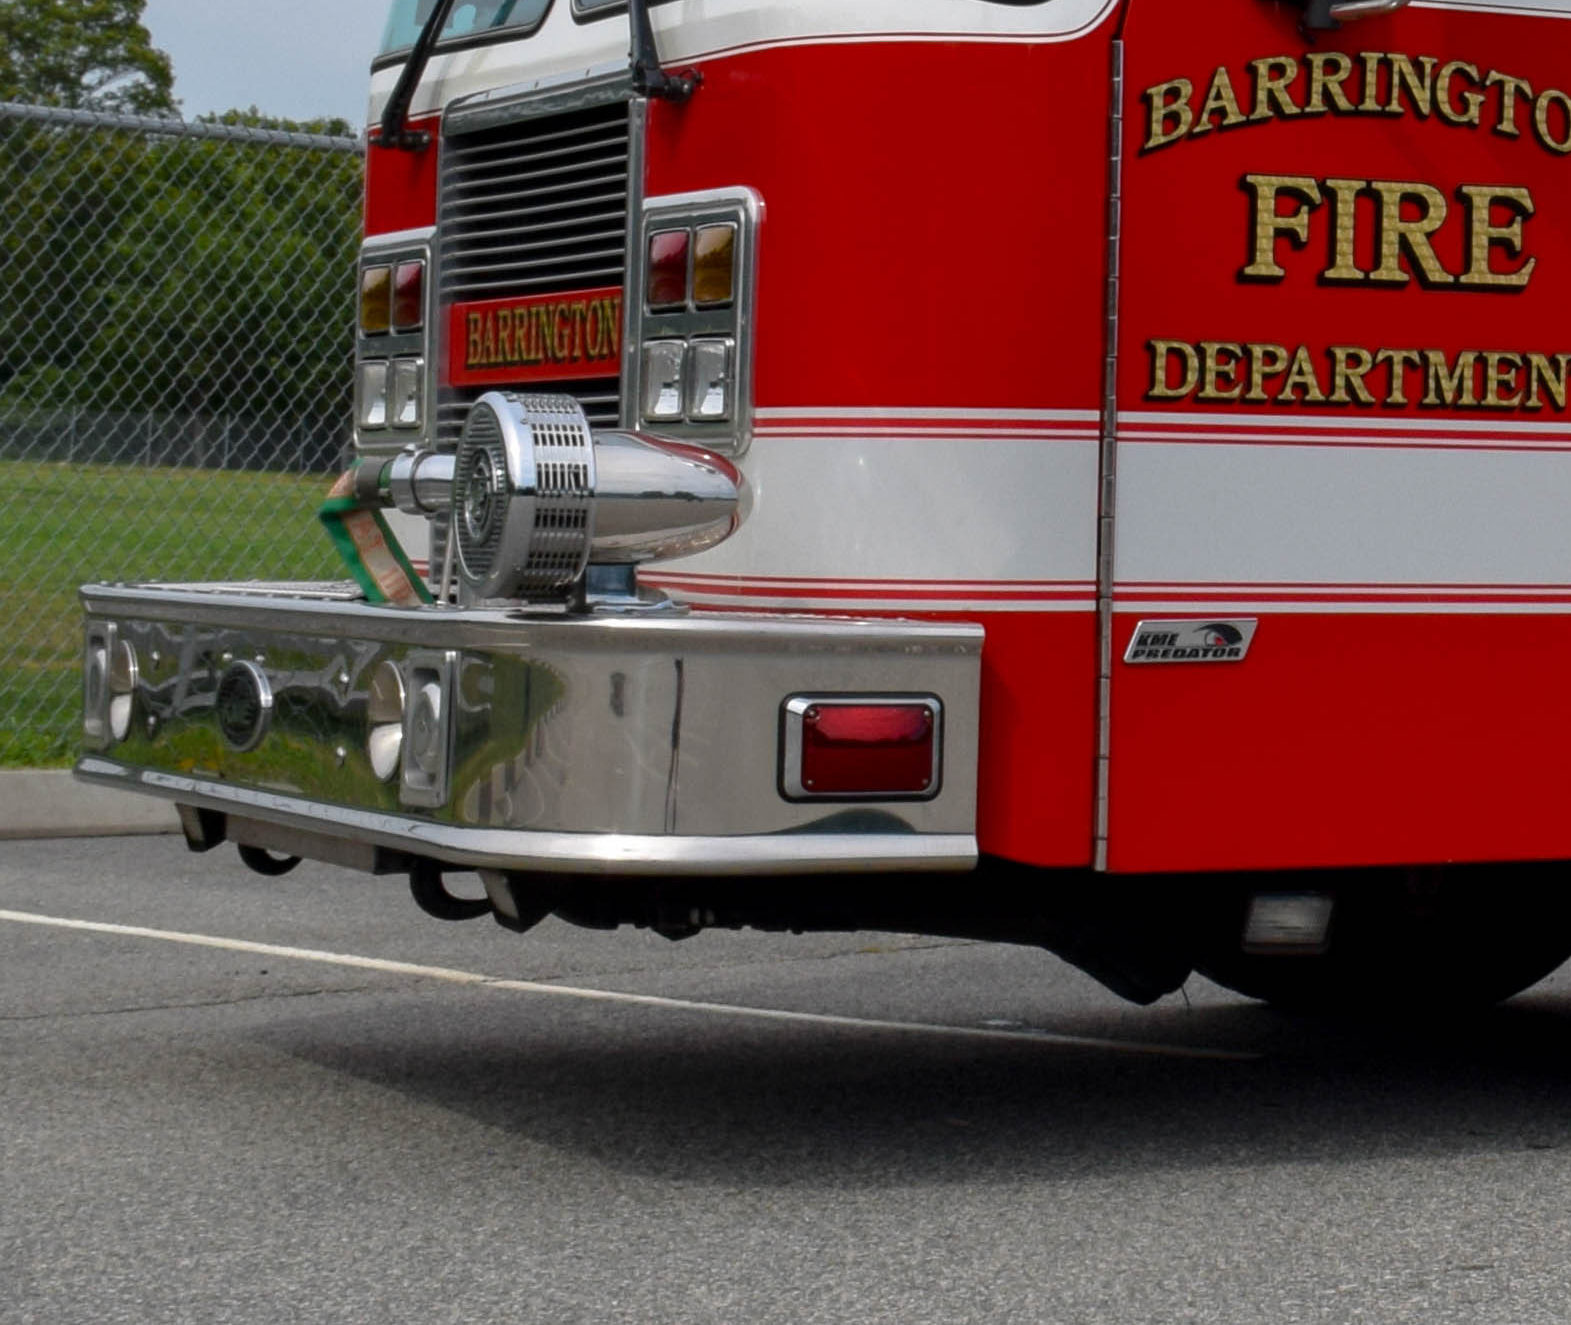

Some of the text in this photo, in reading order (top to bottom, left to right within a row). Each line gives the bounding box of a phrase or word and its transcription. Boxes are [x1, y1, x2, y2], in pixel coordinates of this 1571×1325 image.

[1238, 173, 1536, 290] FIRE
[466, 298, 621, 368] BARRINGTON
[1132, 647, 1241, 660] PREDATOR
[1137, 632, 1180, 647] KME
